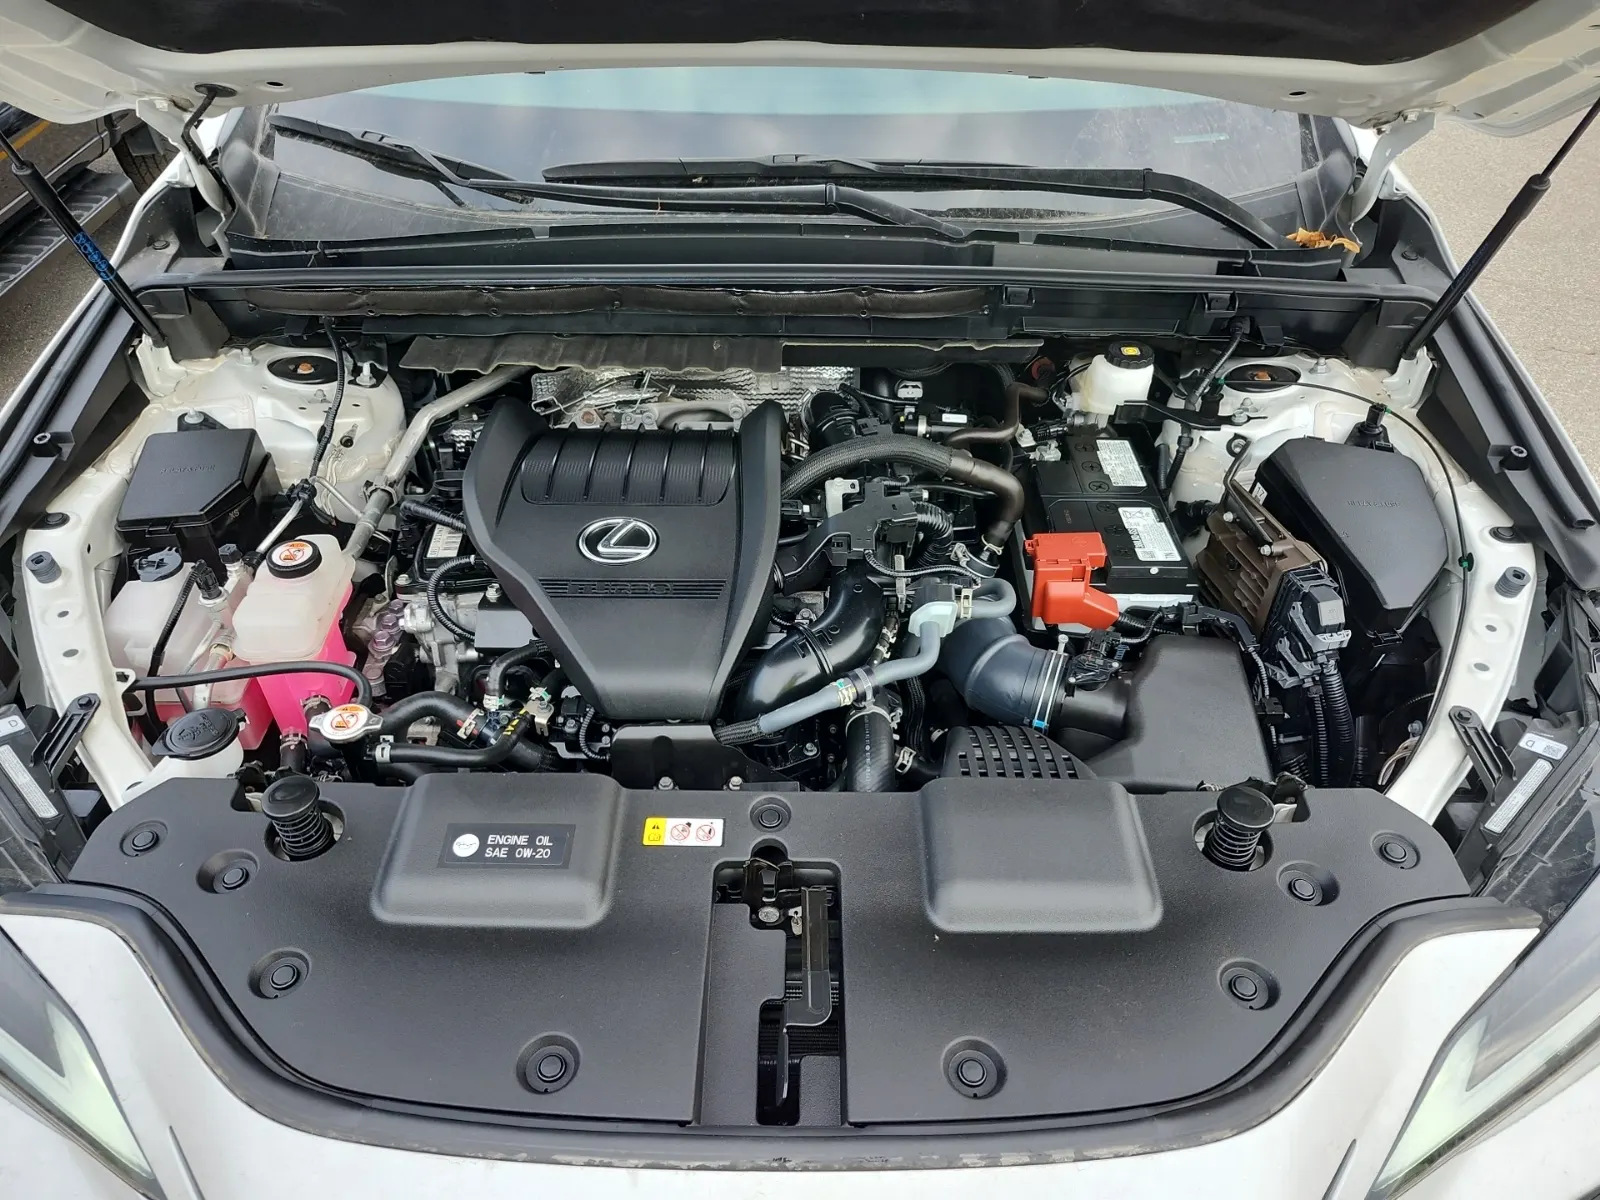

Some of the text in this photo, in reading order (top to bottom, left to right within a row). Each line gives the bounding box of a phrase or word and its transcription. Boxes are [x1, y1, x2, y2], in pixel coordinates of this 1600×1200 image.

[487, 834, 554, 846] ENGINE OIL
[485, 847, 551, 859] SAE 0W-20
